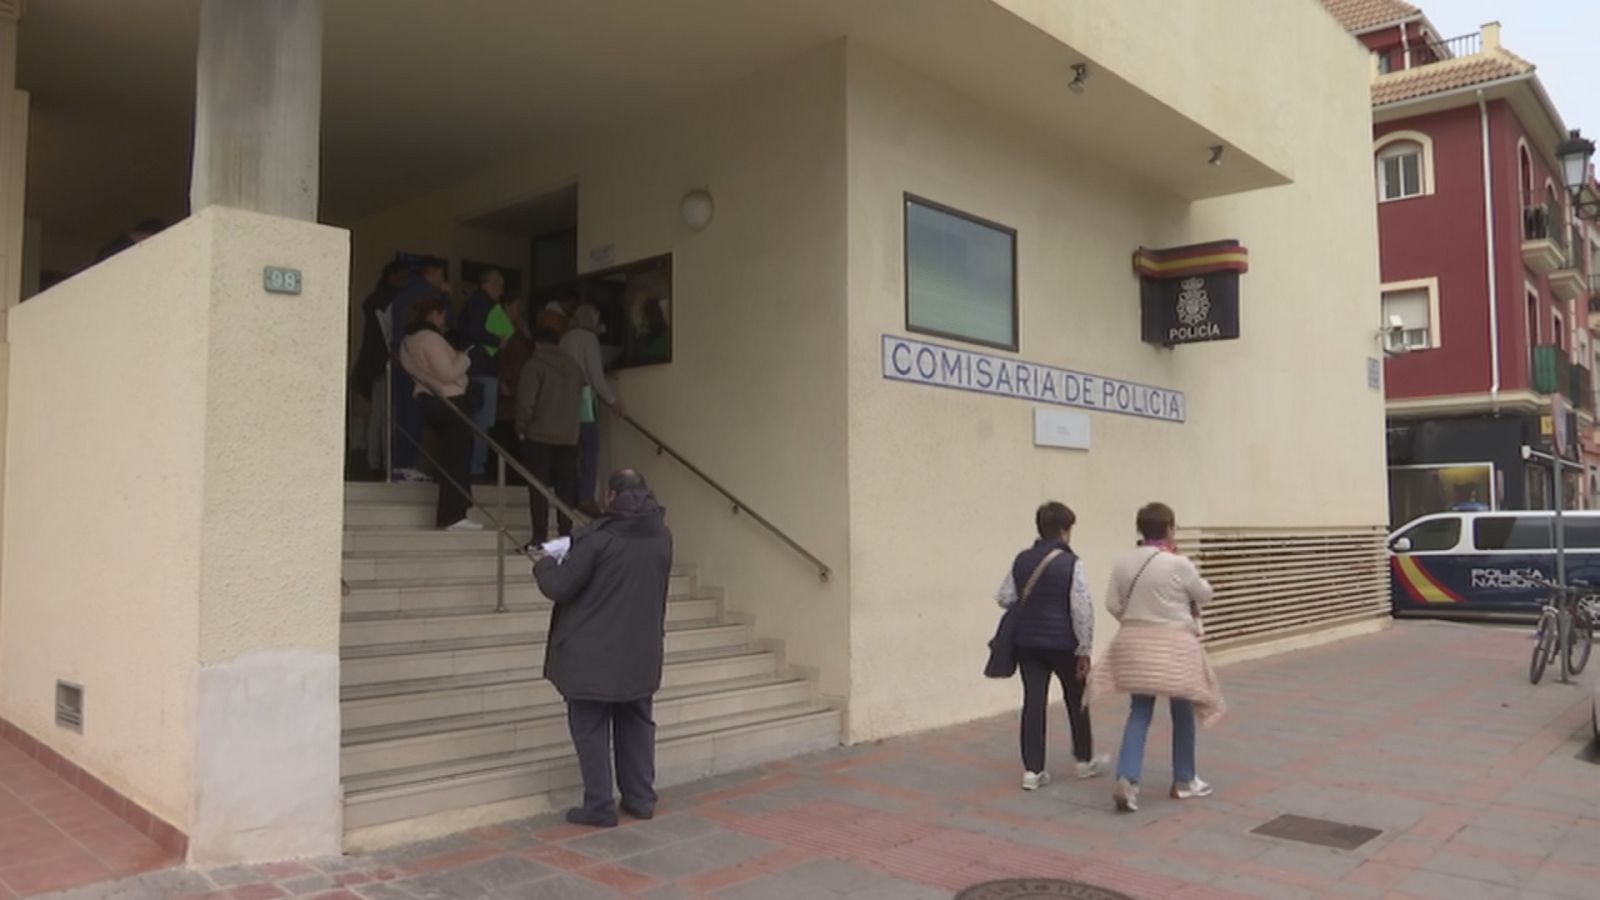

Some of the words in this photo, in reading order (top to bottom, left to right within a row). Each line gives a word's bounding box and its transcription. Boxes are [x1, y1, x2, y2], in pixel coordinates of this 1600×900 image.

[271, 270, 296, 290] 98
[1169, 322, 1220, 340] POLICÍA
[892, 342, 1058, 400] COMISARIA
[1065, 374, 1095, 405] DE
[1103, 381, 1180, 418] POLICIA
